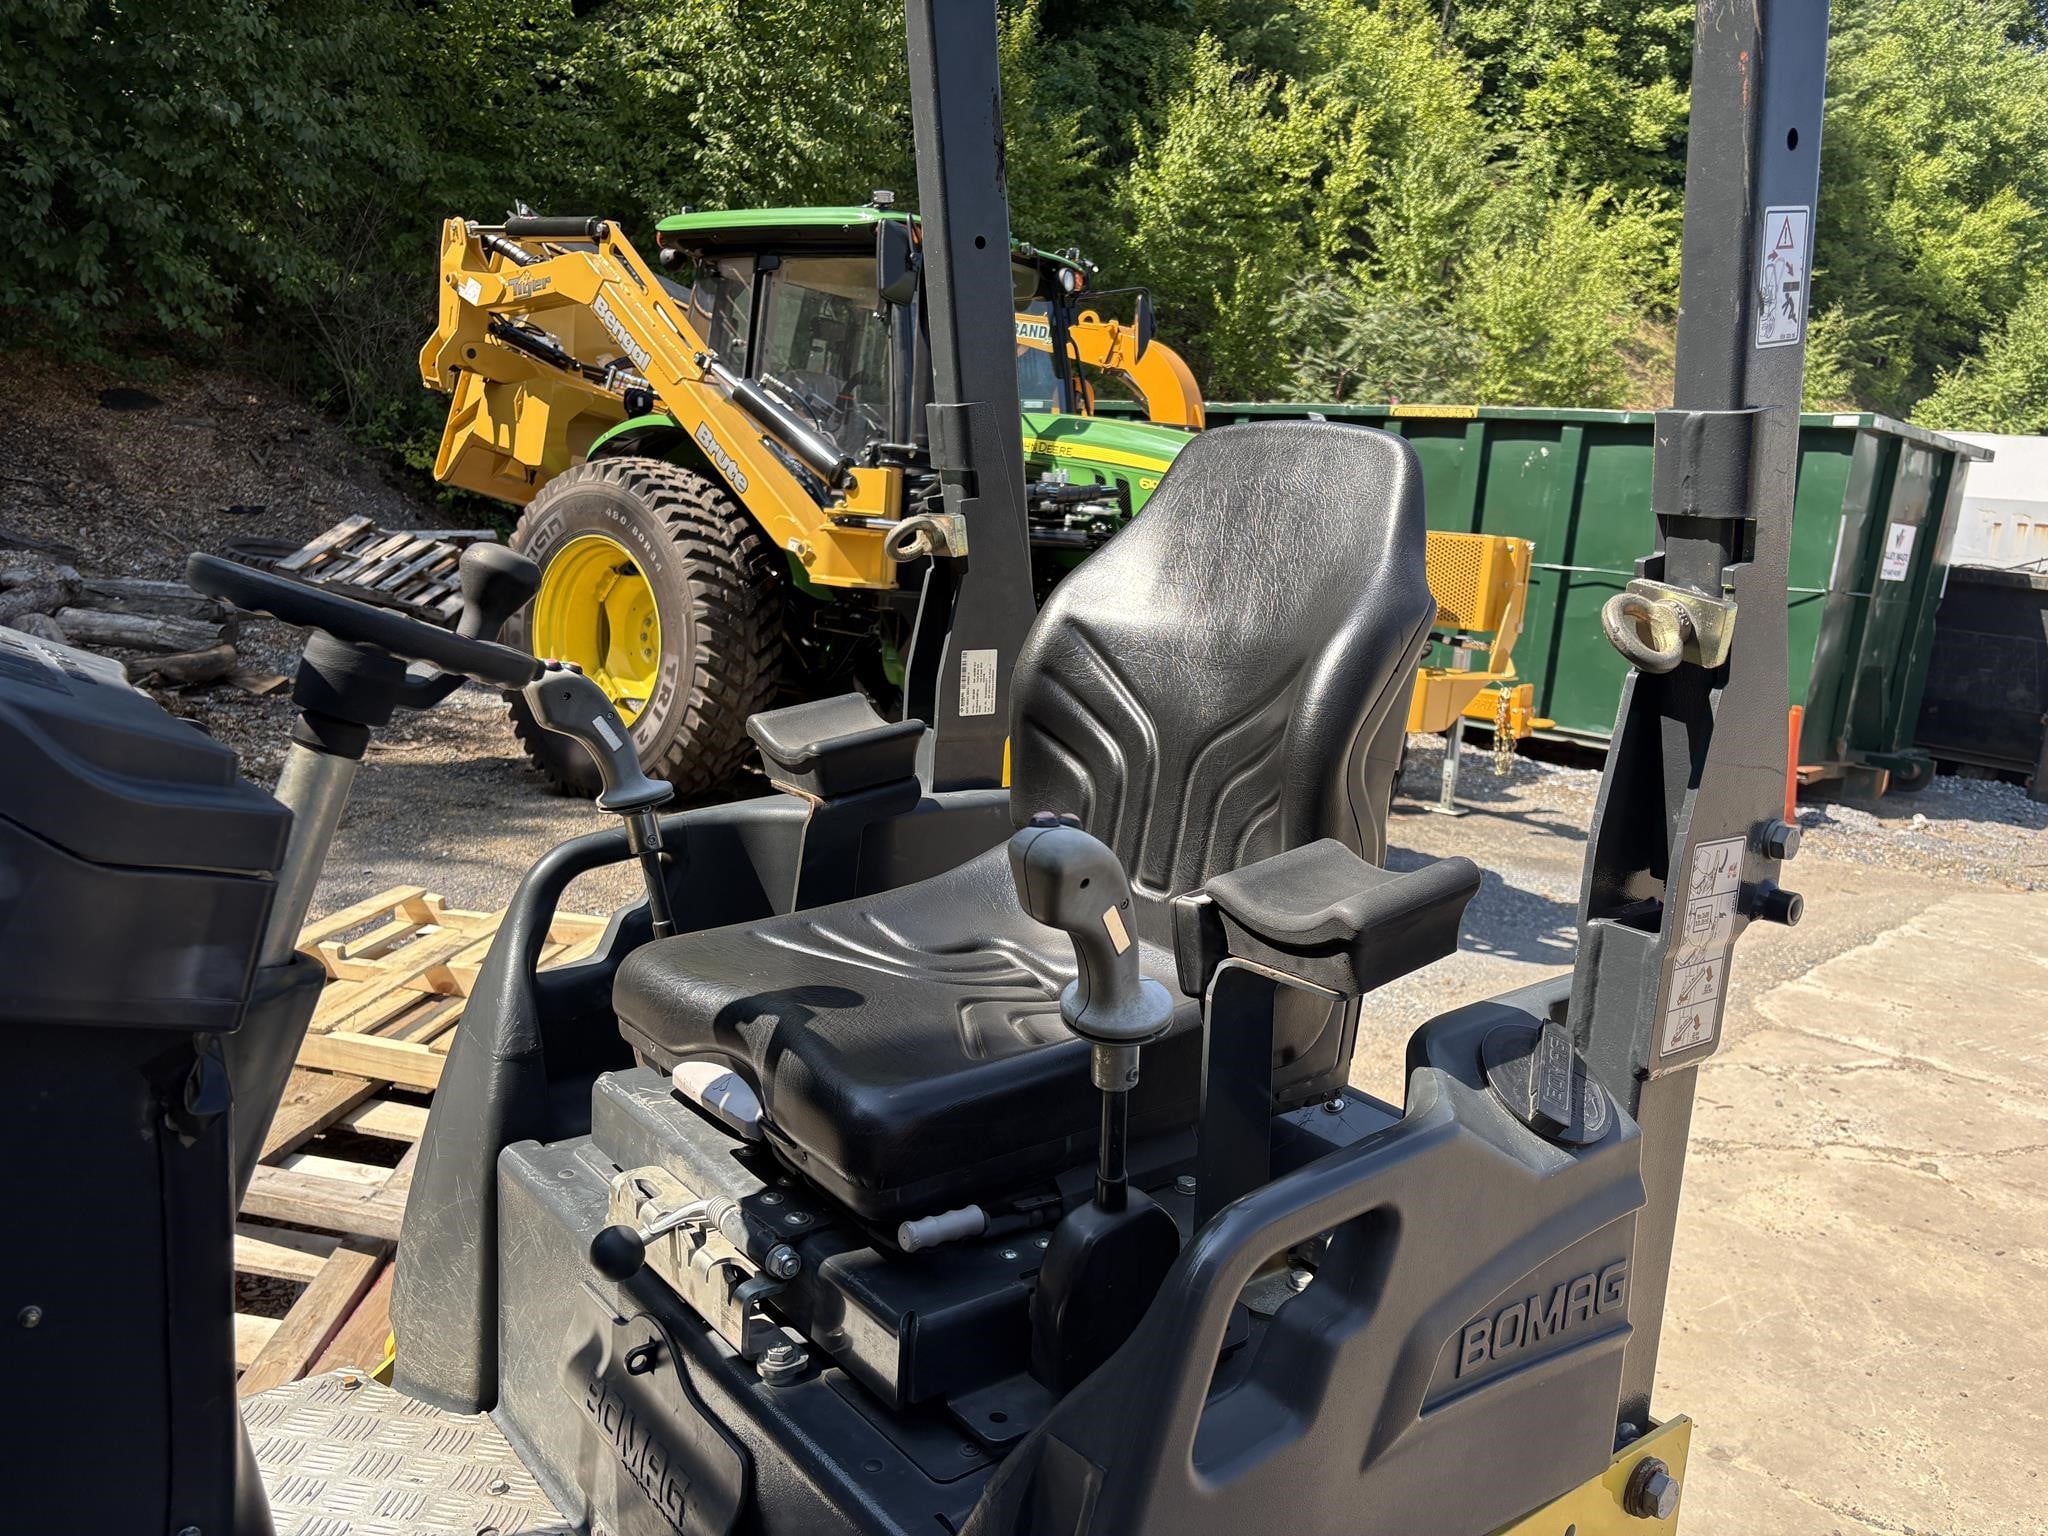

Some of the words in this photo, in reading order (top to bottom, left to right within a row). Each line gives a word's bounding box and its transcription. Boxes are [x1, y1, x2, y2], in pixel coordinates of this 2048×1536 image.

[508, 276, 551, 300] Tiger
[593, 294, 652, 372] Bengal
[694, 420, 748, 494] Brute
[1039, 441, 1073, 456] DEERE
[653, 662, 677, 722] TRI
[1456, 1259, 1628, 1379] BOMAG
[586, 1374, 692, 1529] BOMAG
